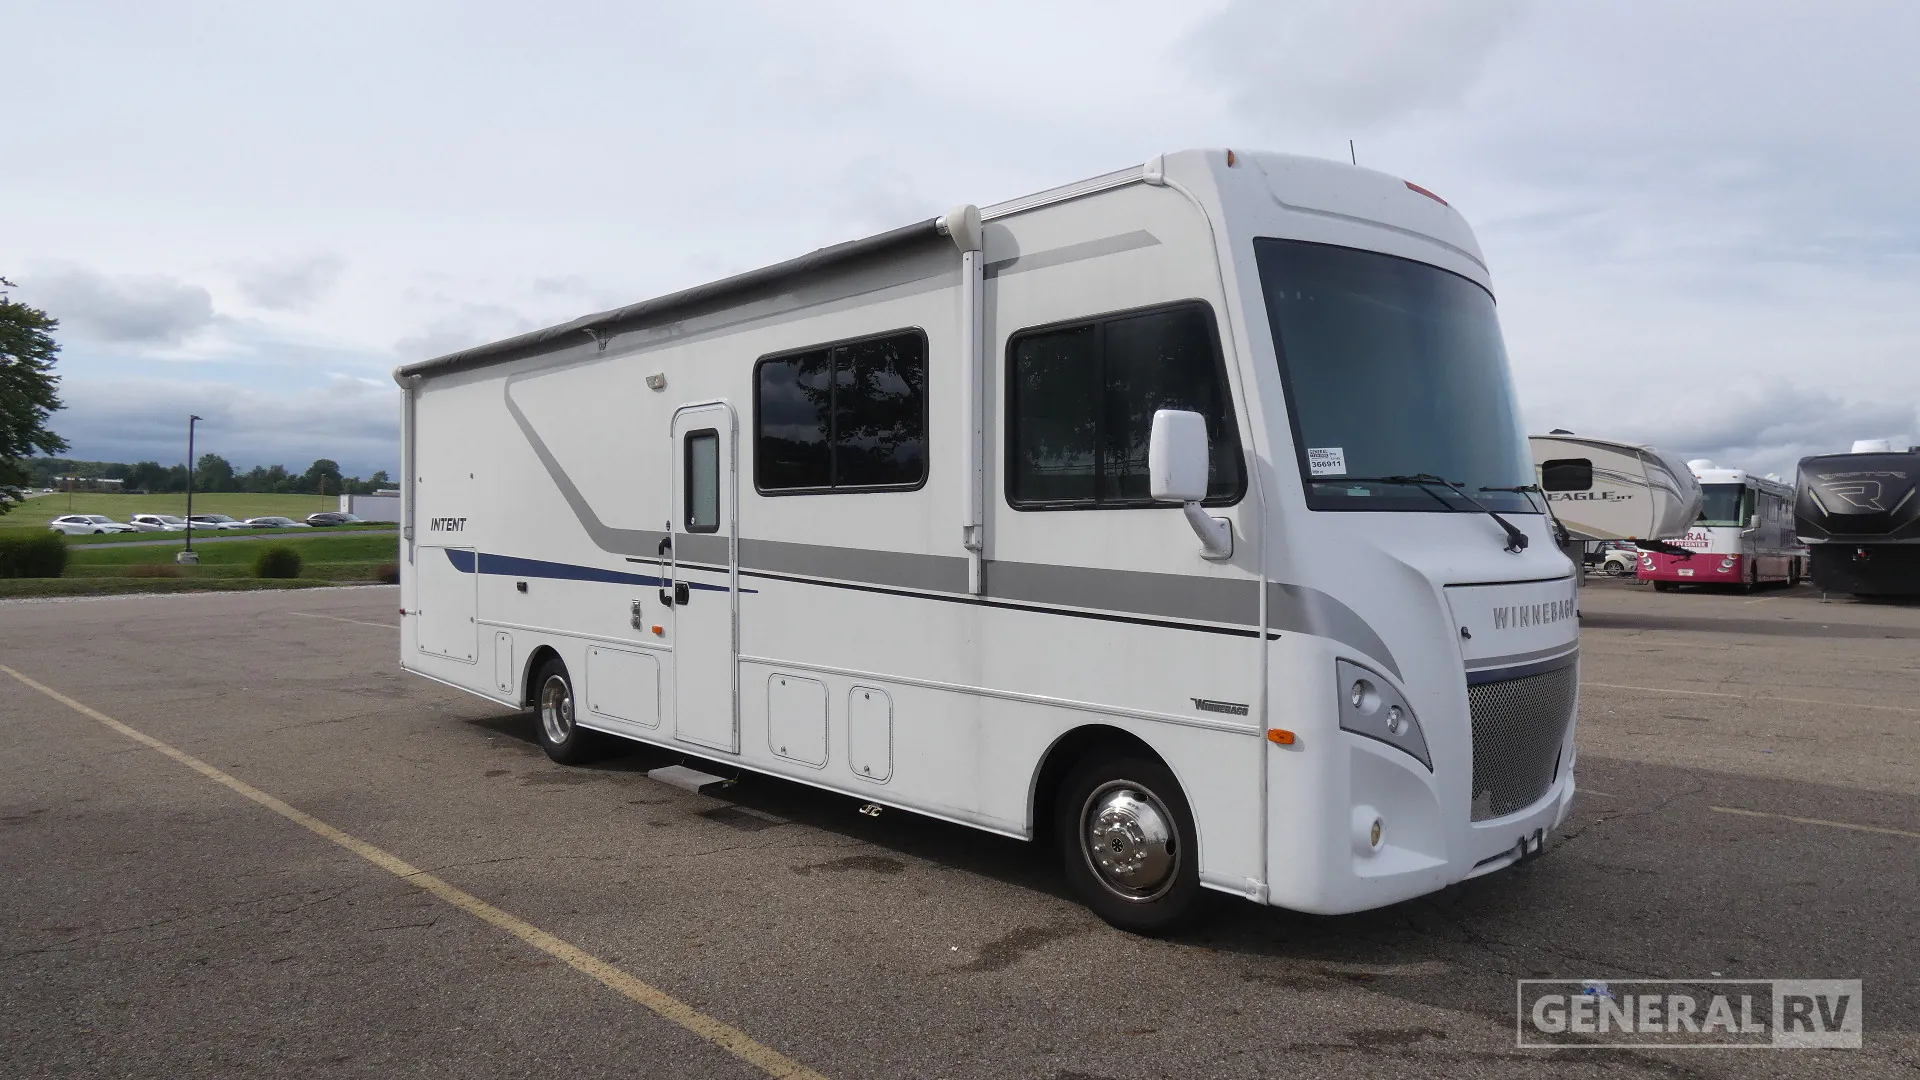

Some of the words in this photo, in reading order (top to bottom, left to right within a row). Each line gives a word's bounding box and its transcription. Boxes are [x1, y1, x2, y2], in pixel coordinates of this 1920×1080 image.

[1547, 491, 1616, 501] EAGLE
[431, 517, 467, 531] INTENT
[1493, 598, 1574, 629] WINNEBAGO
[1190, 697, 1249, 716] WINNEBAGO
